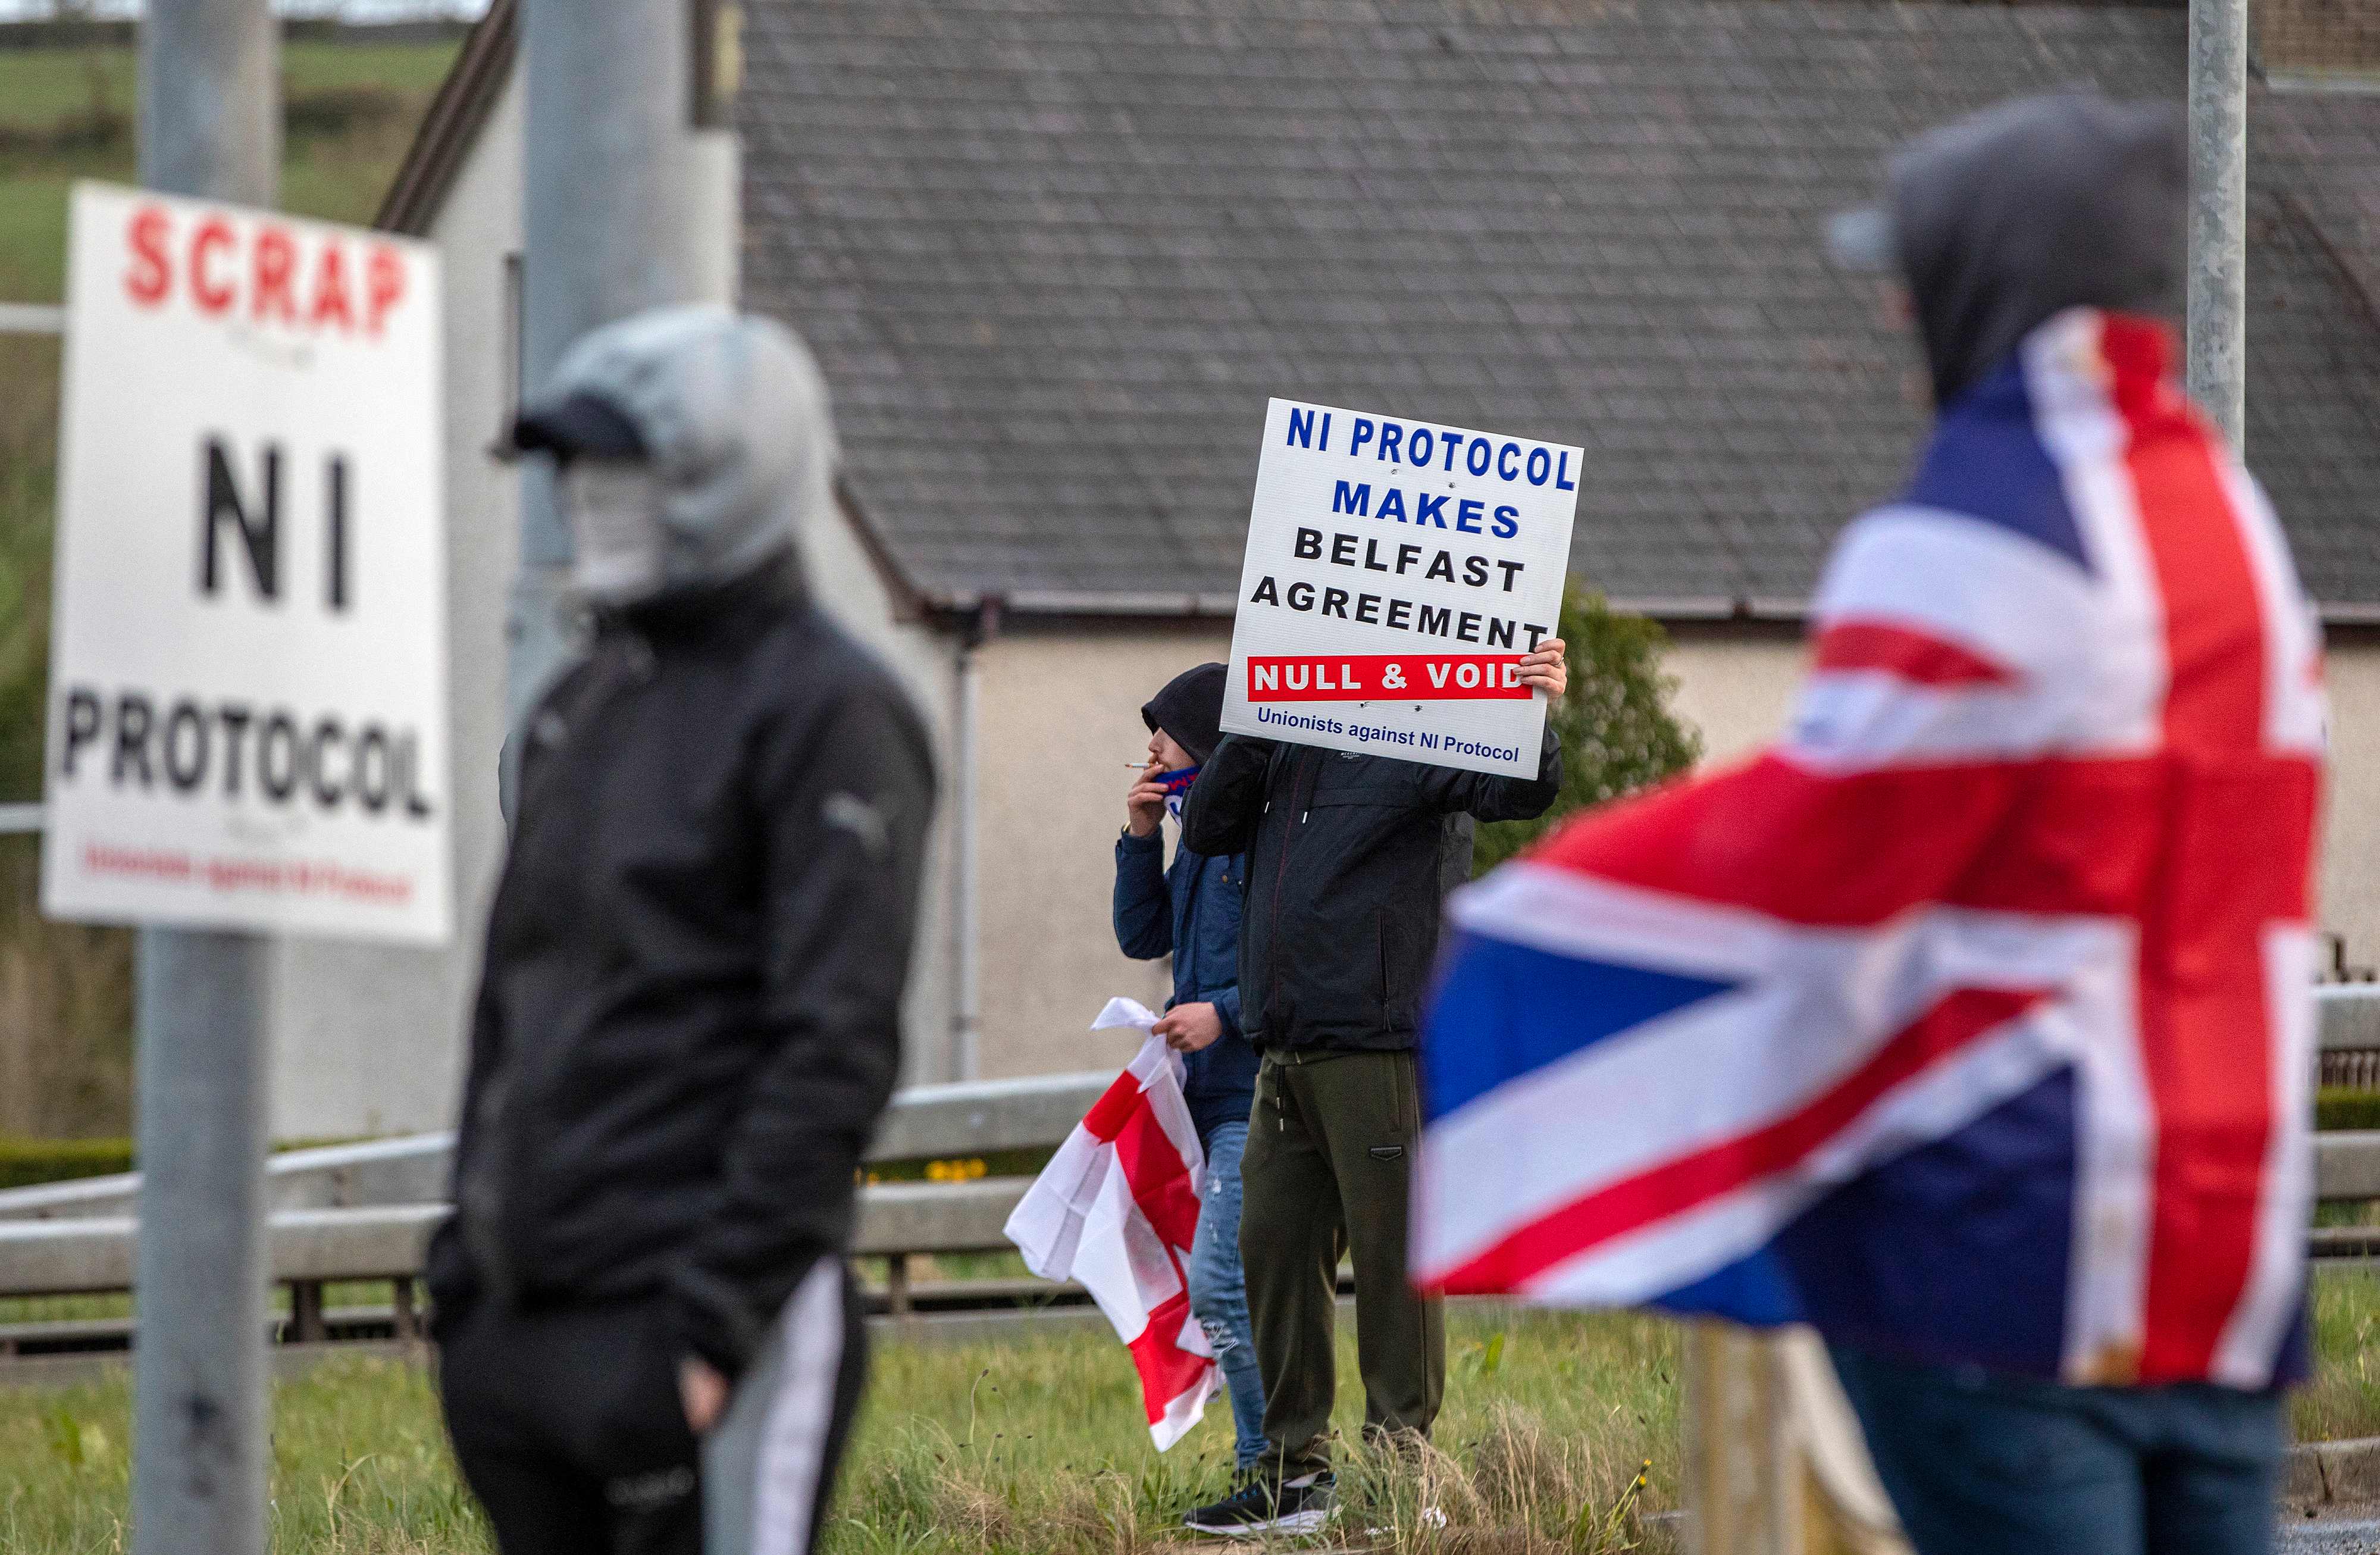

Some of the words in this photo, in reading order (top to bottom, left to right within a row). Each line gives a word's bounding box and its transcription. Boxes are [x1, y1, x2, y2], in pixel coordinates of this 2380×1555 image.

[124, 204, 409, 342] SCRAP
[1286, 407, 1332, 452] NI
[1350, 417, 1575, 492] PROTOCOL
[196, 430, 353, 612] NI
[1332, 480, 1520, 539] MAKES
[1294, 527, 1525, 592] BELFAST
[1250, 575, 1548, 653] AGREEMENT
[1255, 664, 1361, 690] NULL
[1382, 664, 1407, 689] &
[1427, 663, 1523, 689] VOID
[60, 686, 433, 822] PROTOCOL
[1258, 706, 1343, 734] Unionists
[1348, 724, 1416, 746] against
[1420, 732, 1439, 749] NI
[1443, 736, 1519, 762] Protocol
